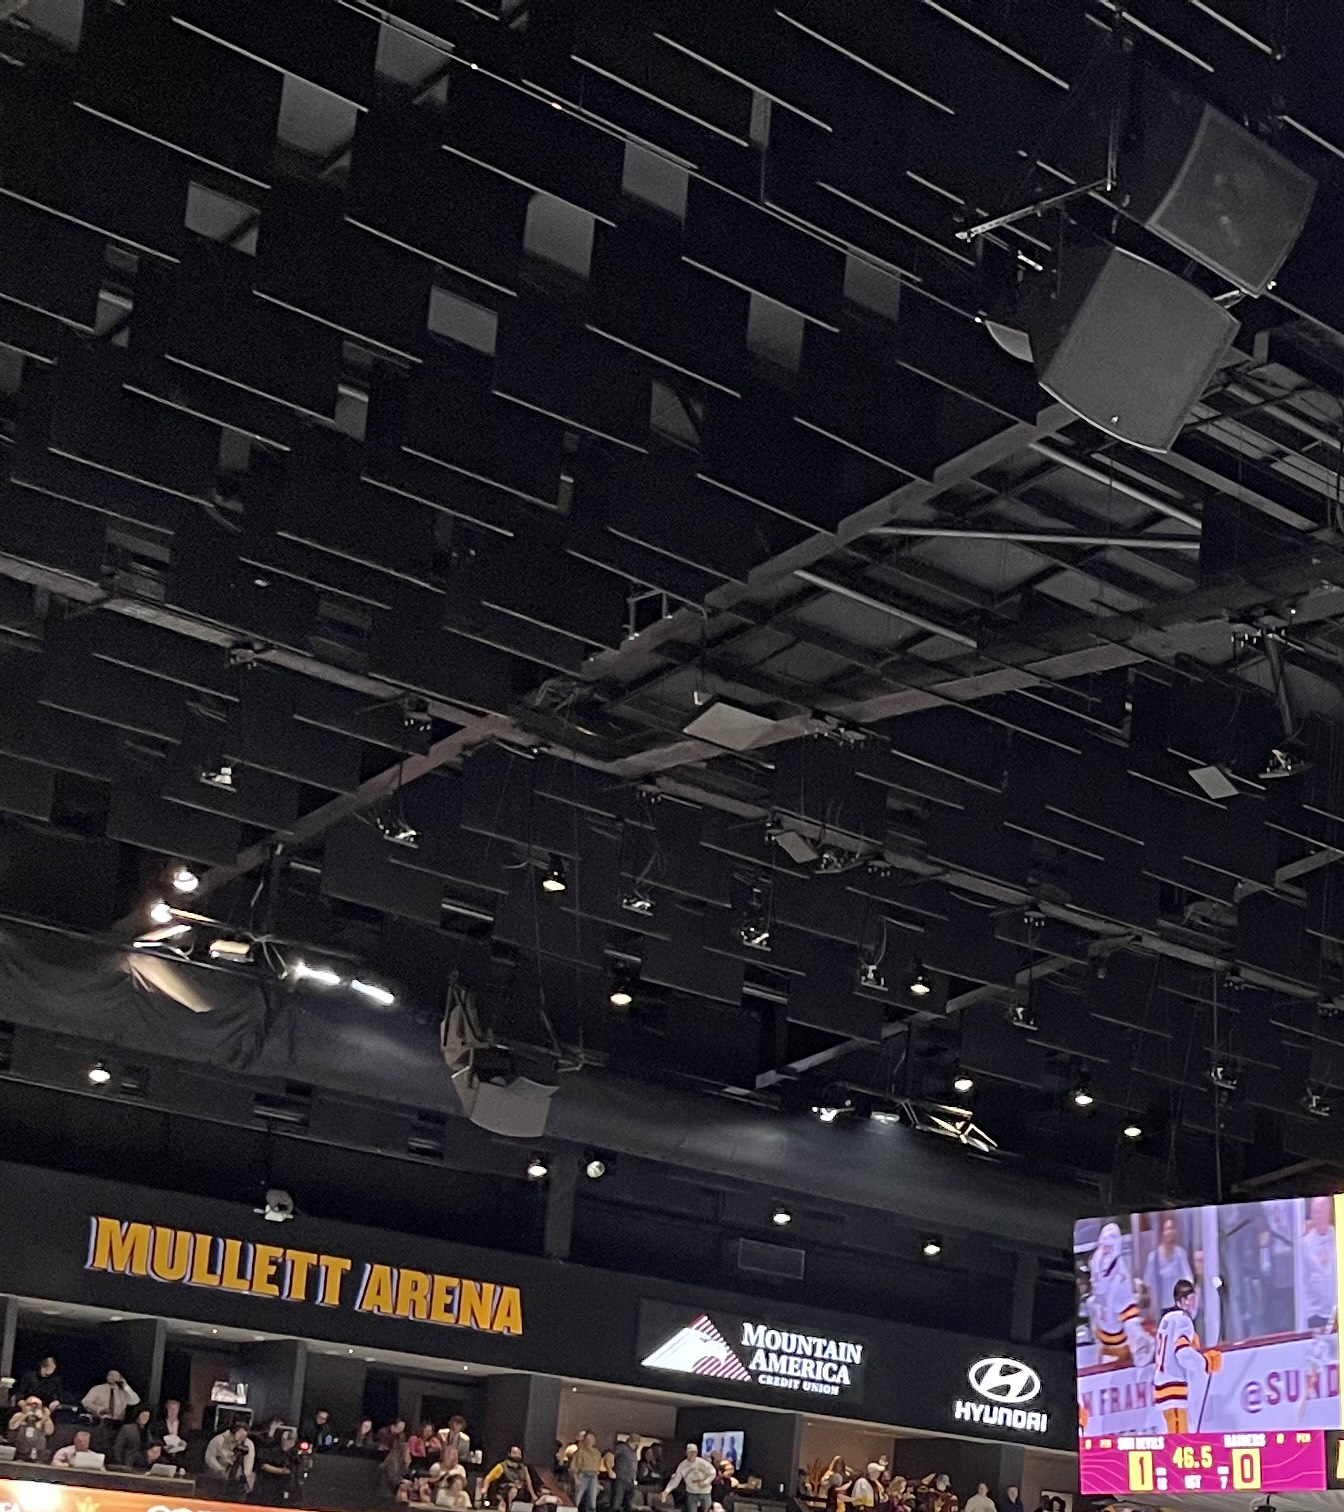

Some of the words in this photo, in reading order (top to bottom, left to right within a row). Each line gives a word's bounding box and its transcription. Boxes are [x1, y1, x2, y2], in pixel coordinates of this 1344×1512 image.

[86, 1216, 351, 1308] MULLETT
[355, 1263, 523, 1336] ARENA
[741, 1322, 863, 1364] MOUNTAIN
[748, 1349, 851, 1385] AMERICA
[758, 1374, 801, 1389] CREDIT
[802, 1380, 839, 1396] UNION
[955, 1400, 1048, 1432] HYUNDAI
[1173, 1445, 1213, 1468] 46.5
[1240, 1454, 1254, 1484] 0
